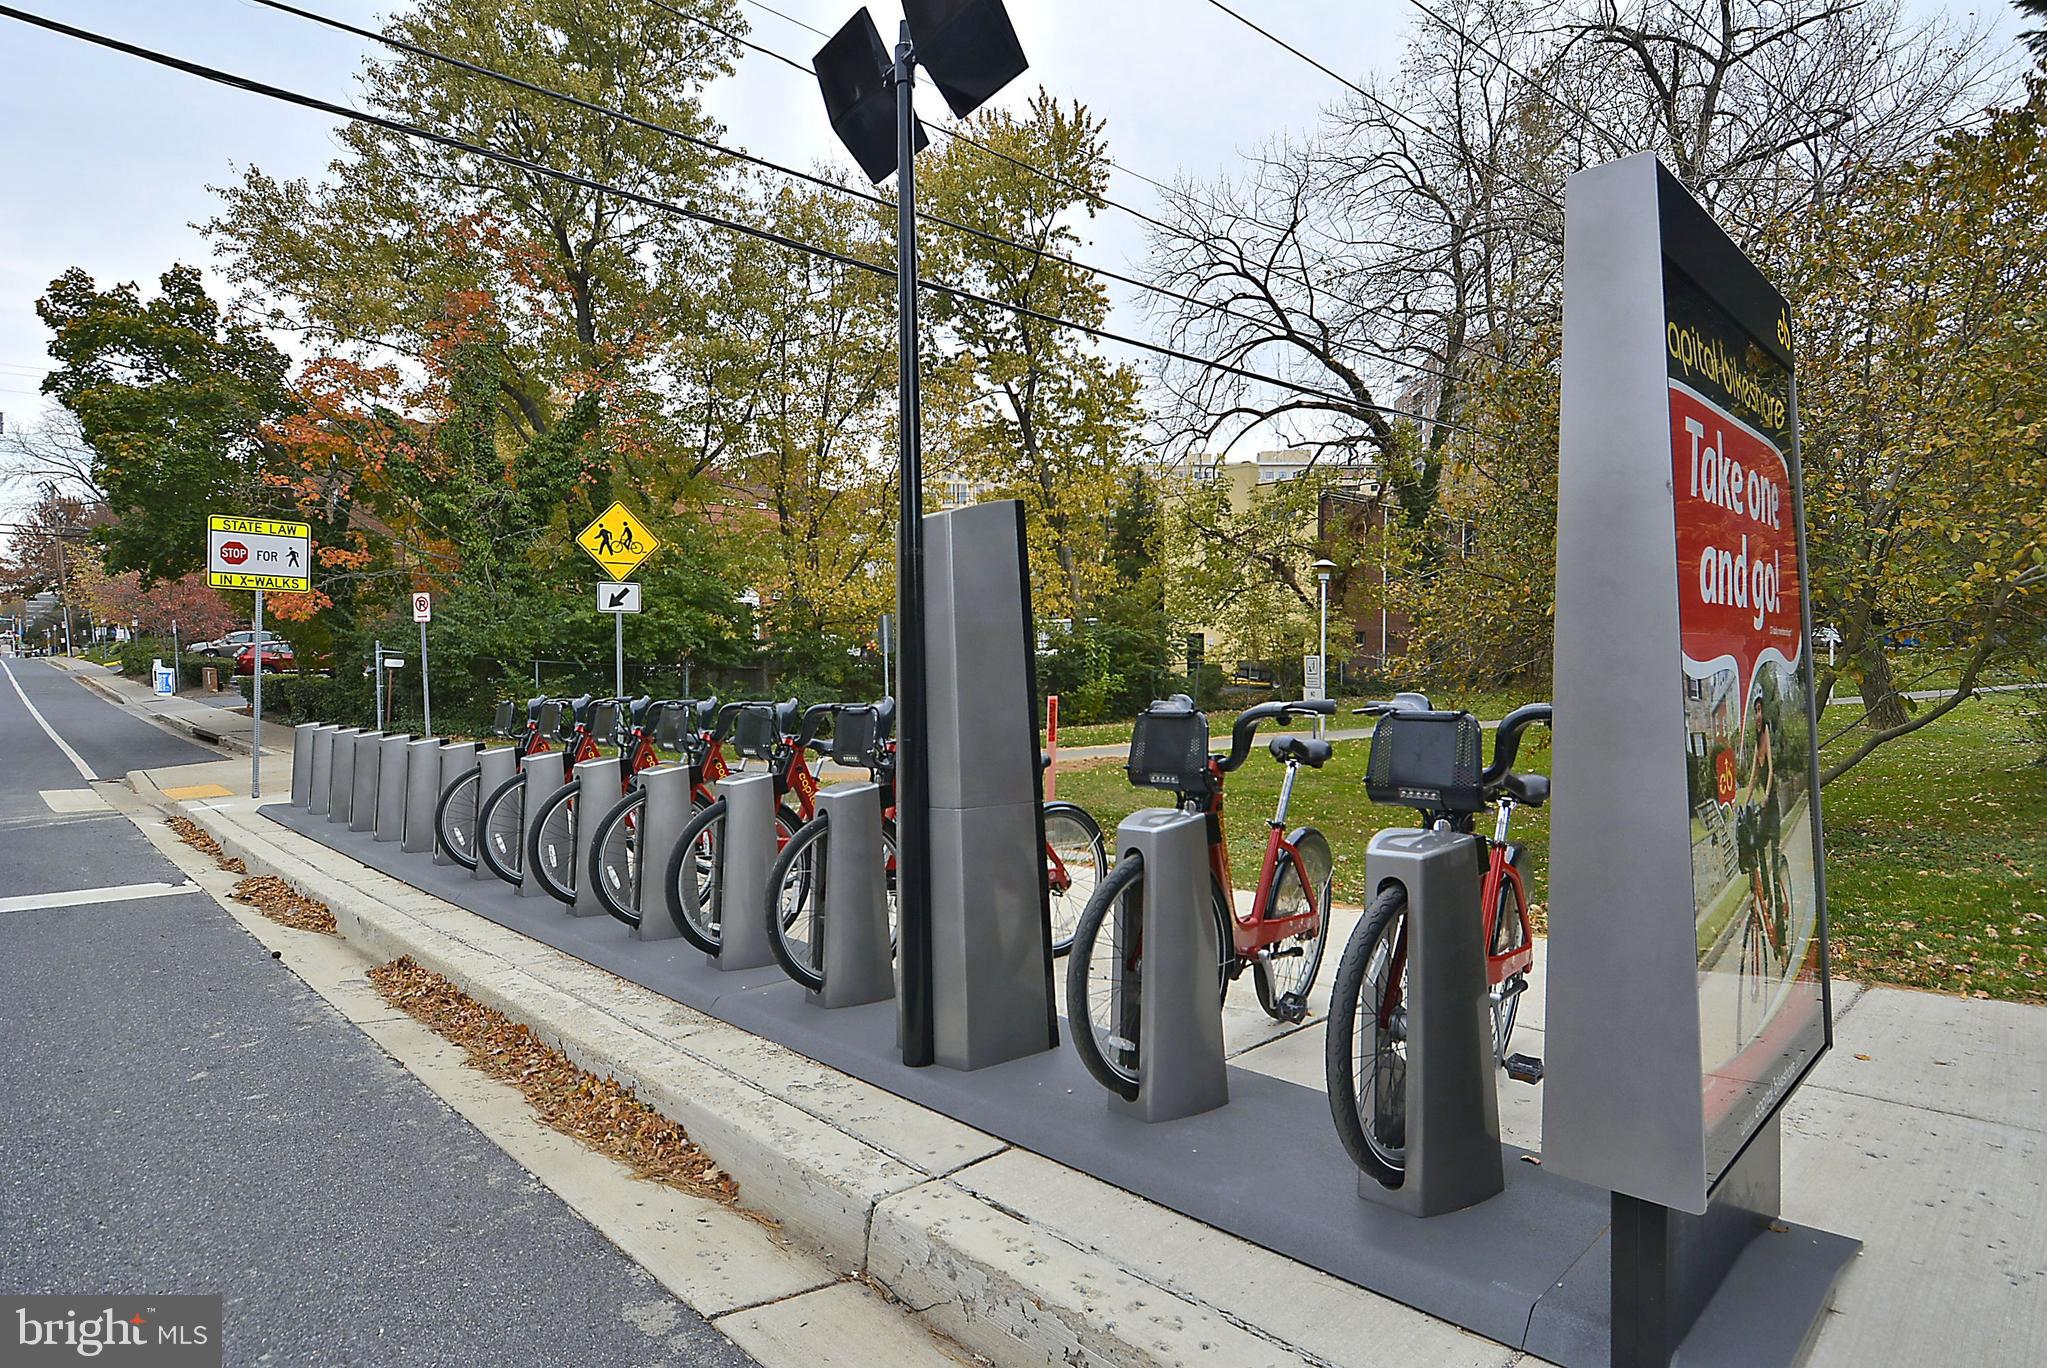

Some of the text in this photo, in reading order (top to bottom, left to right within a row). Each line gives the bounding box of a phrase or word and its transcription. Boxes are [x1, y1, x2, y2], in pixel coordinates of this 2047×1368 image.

[1667, 321, 1719, 384] apital
[1685, 416, 1780, 530] Take one
[223, 520, 297, 536] STATE LAW
[222, 547, 278, 562] STOP FOR
[220, 574, 299, 589] IN X-WALKS
[1700, 534, 1780, 631] and go!
